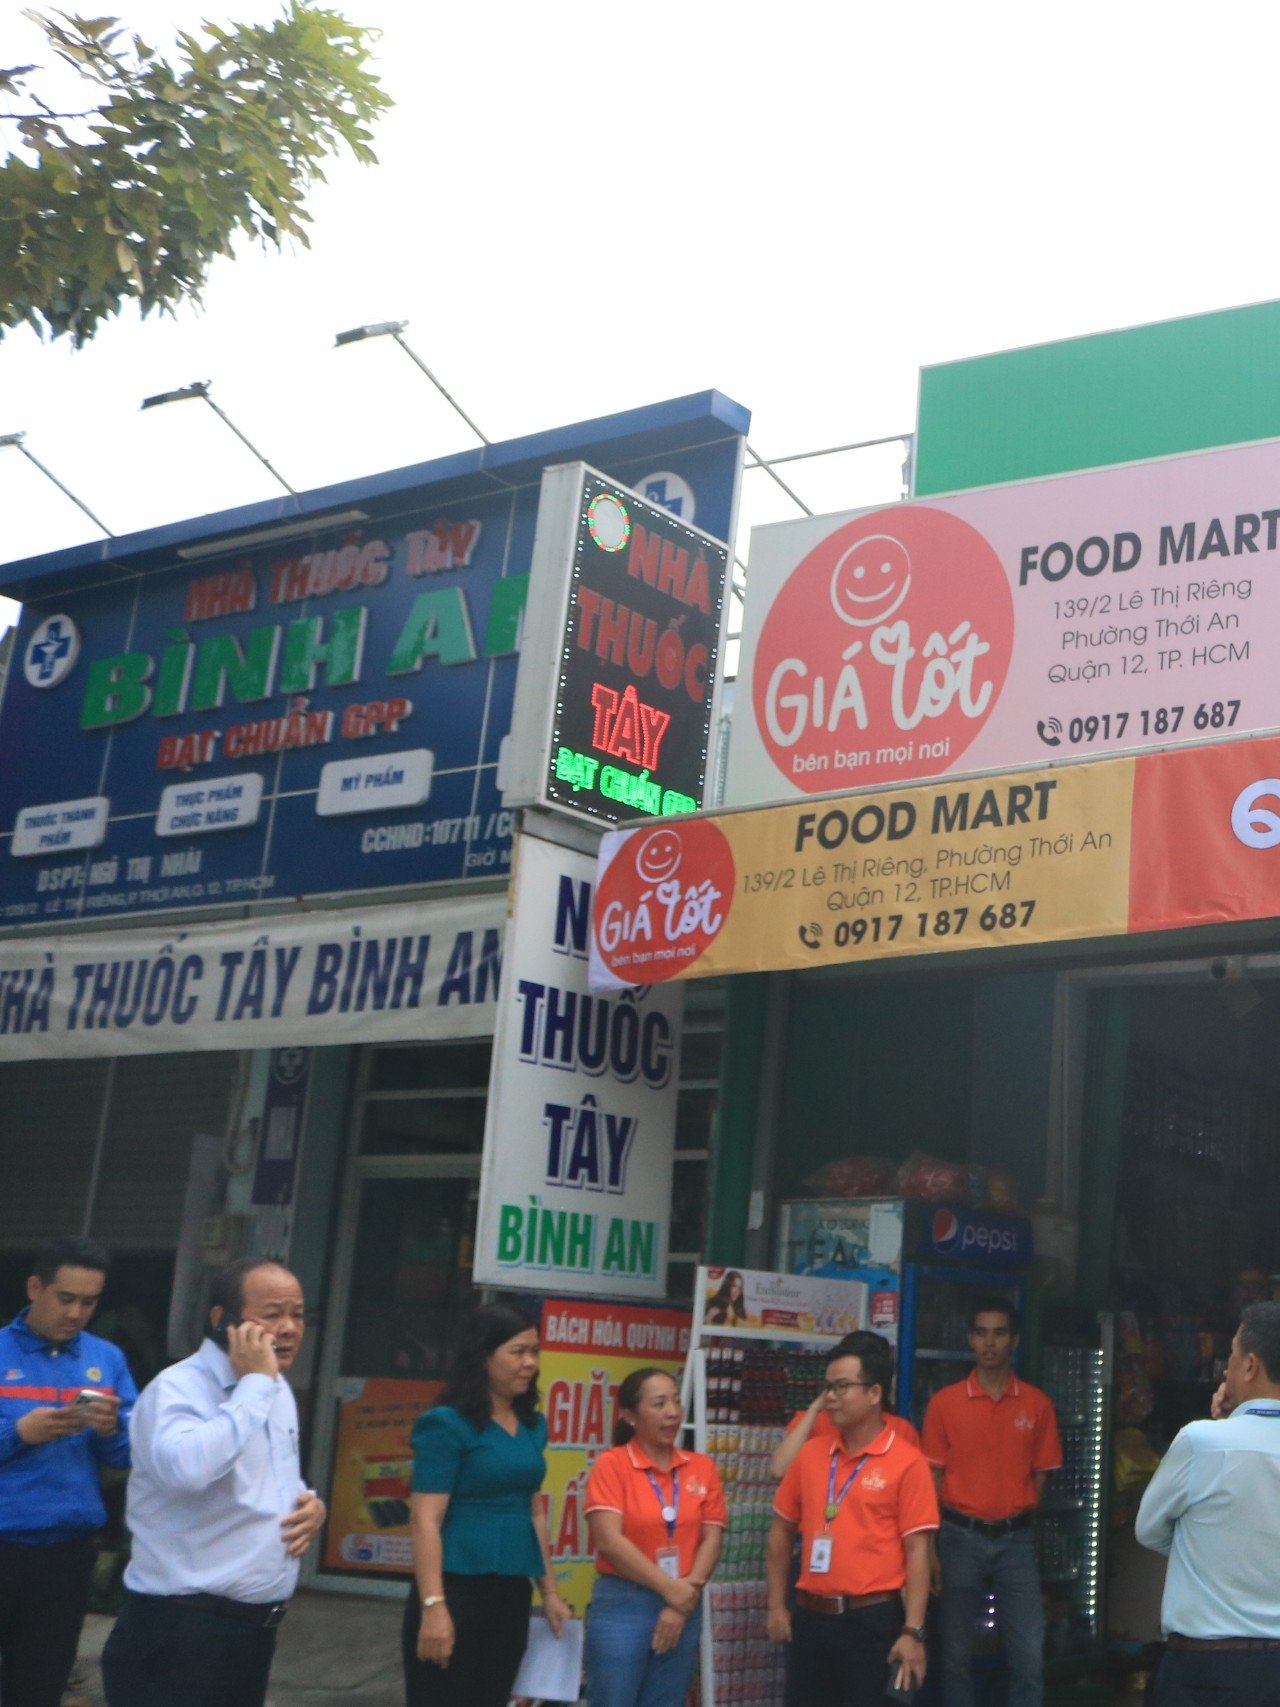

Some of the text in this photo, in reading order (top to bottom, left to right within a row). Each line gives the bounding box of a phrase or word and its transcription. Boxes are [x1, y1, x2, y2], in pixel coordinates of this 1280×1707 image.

[183, 519, 483, 622] NHÀ THUỐC TÂY
[627, 523, 712, 615] NHÀ
[1018, 531, 1143, 586] FOOD
[1052, 577, 1254, 621] 139/2 Lê Thị Riêng
[576, 585, 709, 703] THUỐC
[1062, 611, 1240, 651] Phường Thới An
[80, 606, 370, 731] BÌNH
[764, 640, 870, 748] GIÁ
[1048, 640, 1252, 686] Quận 12, TP. HCM
[156, 696, 413, 771] ĐẠT CHUẨN GPP
[591, 683, 671, 771] TÂY
[1068, 699, 1242, 745] 0917 187 687
[340, 764, 405, 792] MỸ PHẨM
[555, 746, 600, 792] ĐẠT
[792, 739, 952, 775] bên bạn mọi nơi
[794, 780, 1058, 853] FOOD MART
[742, 832, 1112, 896] 139/2 Lê Thị Riêng, Phường Thới An
[600, 889, 653, 952] GIÁ
[827, 886, 884, 914] Quận
[893, 881, 922, 904] 12,
[833, 899, 1037, 948] 0917 187 687
[0, 949, 58, 1036] HÀ
[66, 932, 205, 1030] THUỐC
[216, 935, 310, 1022] TÂY
[306, 924, 431, 1016] BÌNH
[516, 979, 674, 1090] THUỐC
[543, 1093, 638, 1194] TÂY
[496, 1195, 658, 1280] BÌNH AN
[962, 1224, 1018, 1255] pepsi
[546, 1310, 590, 1344] BÁCH
[591, 1314, 624, 1347] HÓA
[626, 1320, 677, 1352] QUỲNH
